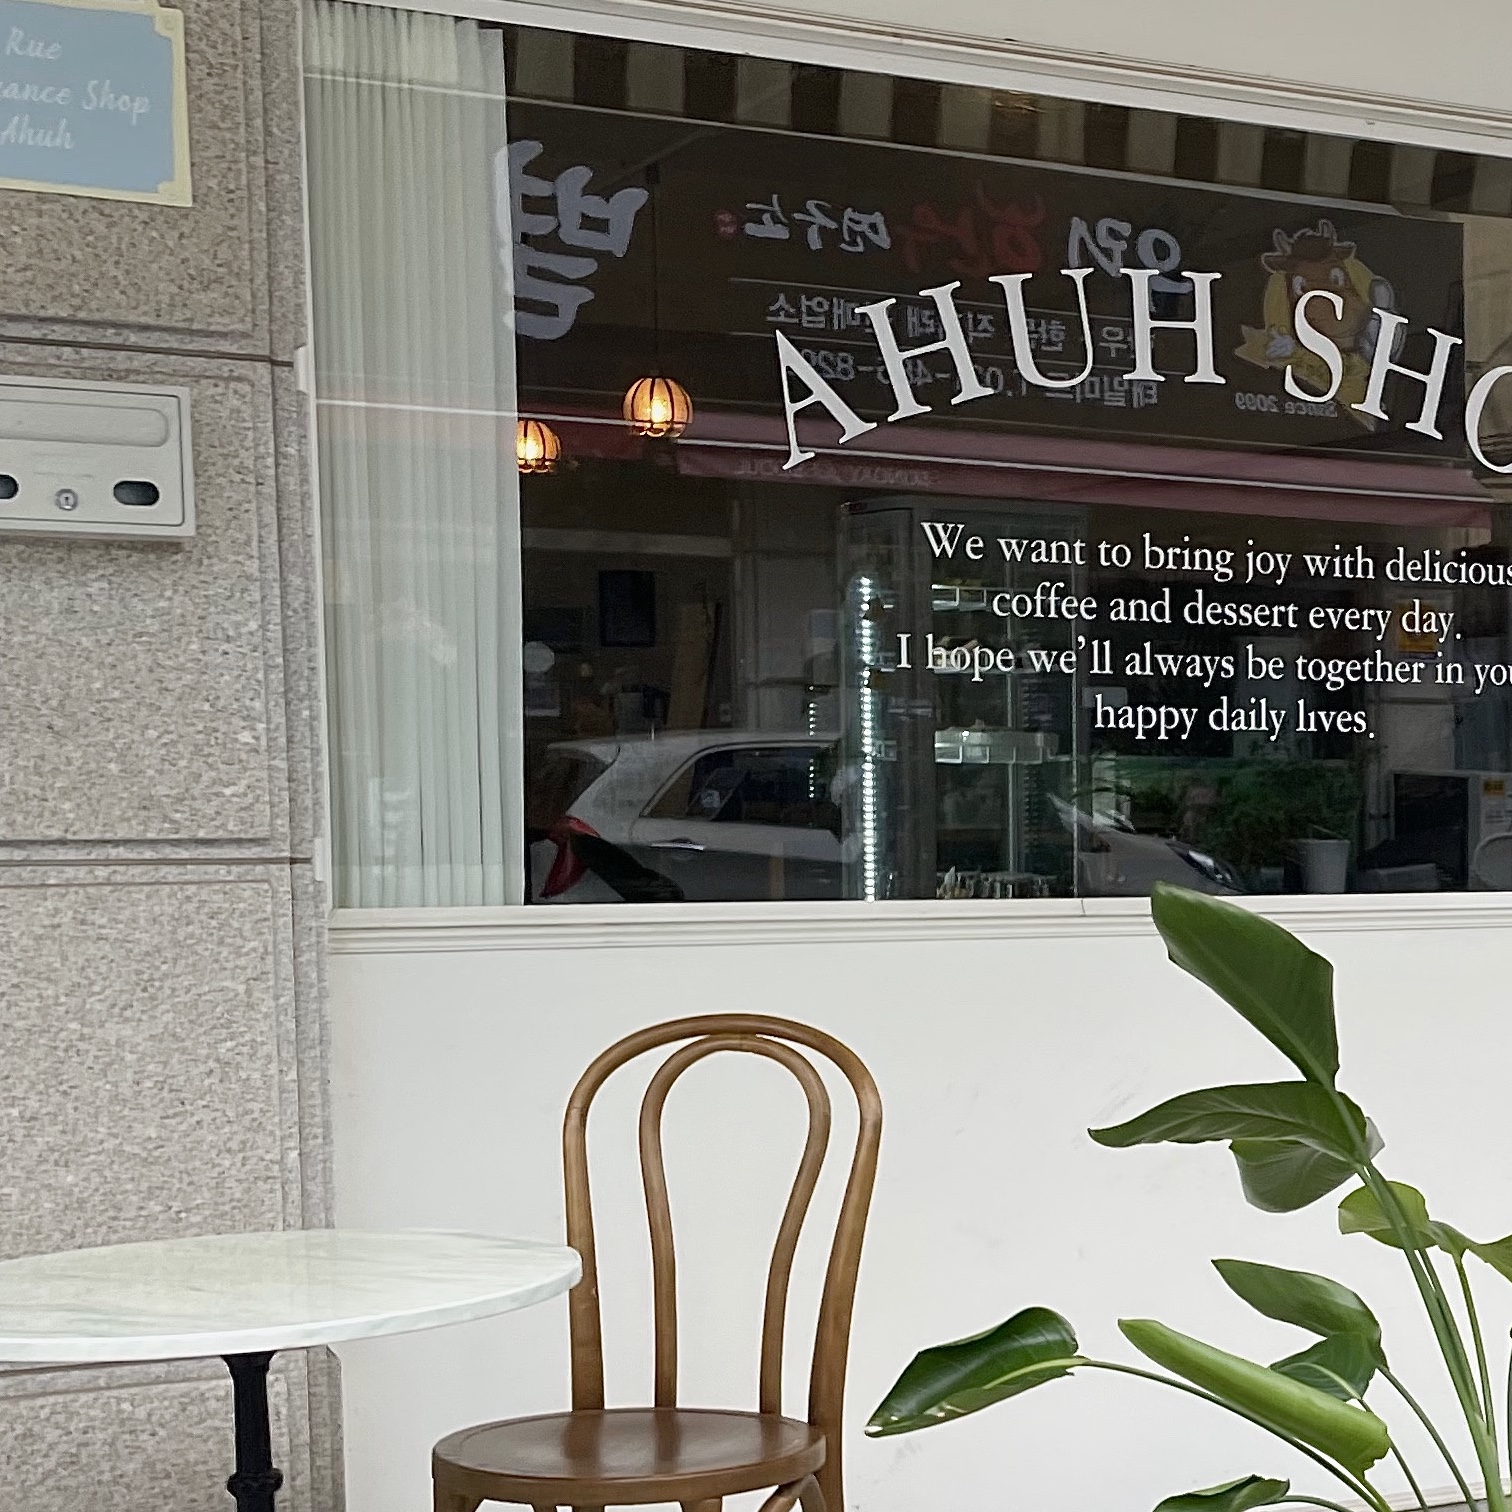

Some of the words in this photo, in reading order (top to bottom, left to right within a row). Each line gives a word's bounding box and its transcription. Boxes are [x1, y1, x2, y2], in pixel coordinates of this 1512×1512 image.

[6, 26, 63, 60] Rue
[0, 80, 71, 105] ance
[82, 79, 150, 127] Shop
[775, 267, 1226, 471] AHUH
[920, 522, 984, 560] We
[996, 538, 1086, 565] want
[1097, 540, 1132, 568] to
[1142, 532, 1235, 583] bring
[1245, 539, 1292, 585] joy
[1302, 544, 1375, 580] with
[992, 582, 1097, 620] coffee
[1109, 587, 1172, 624] and
[1183, 588, 1299, 628] dessert
[1309, 606, 1392, 641] every
[1401, 598, 1461, 644] day.
[896, 633, 912, 669] I
[925, 633, 1015, 682] hope
[1026, 635, 1114, 675] we'll
[1125, 641, 1235, 688] always
[1246, 643, 1284, 680] be
[1295, 649, 1425, 691] together
[1434, 651, 1465, 684] in
[1094, 693, 1199, 740] happy
[1208, 695, 1286, 742] daily
[1295, 698, 1375, 739] lives.
